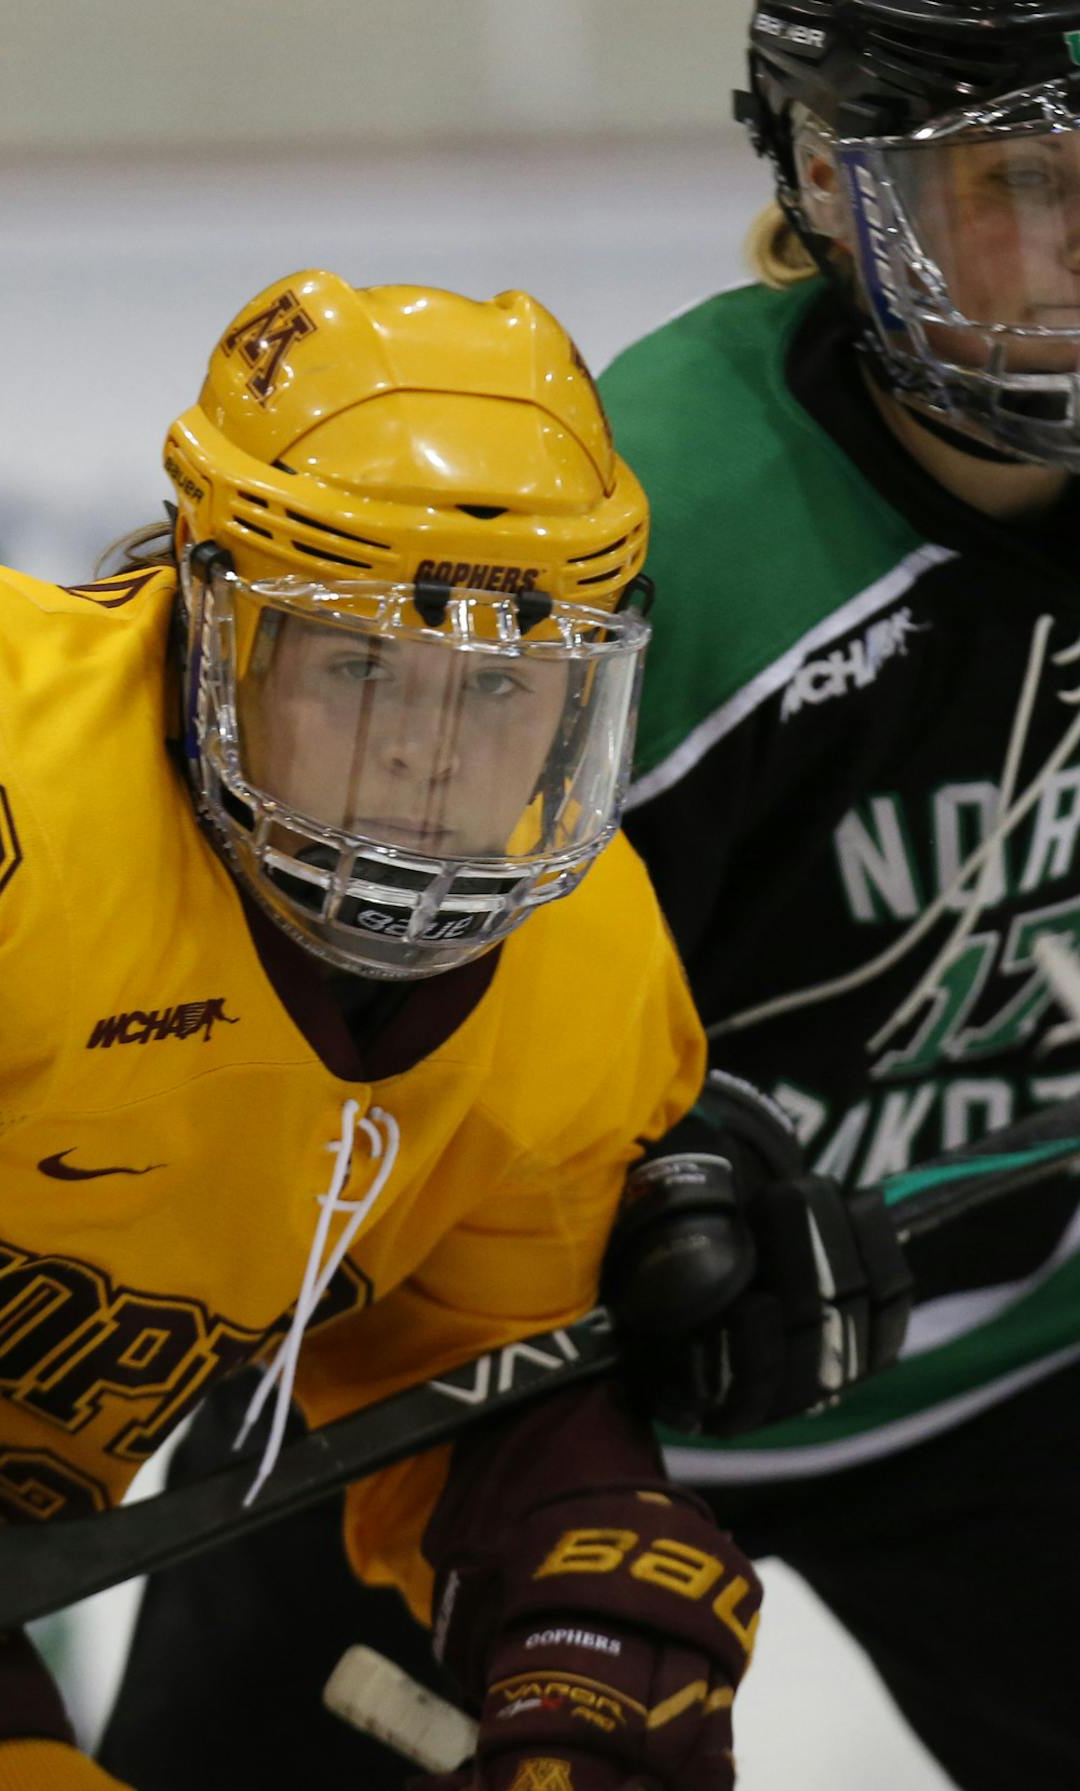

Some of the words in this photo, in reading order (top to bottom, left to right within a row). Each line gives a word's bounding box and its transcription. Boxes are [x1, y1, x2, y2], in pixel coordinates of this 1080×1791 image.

[219, 288, 318, 409] M
[413, 559, 539, 594] GOPHERS
[524, 1627, 621, 1657] GOPHERS
